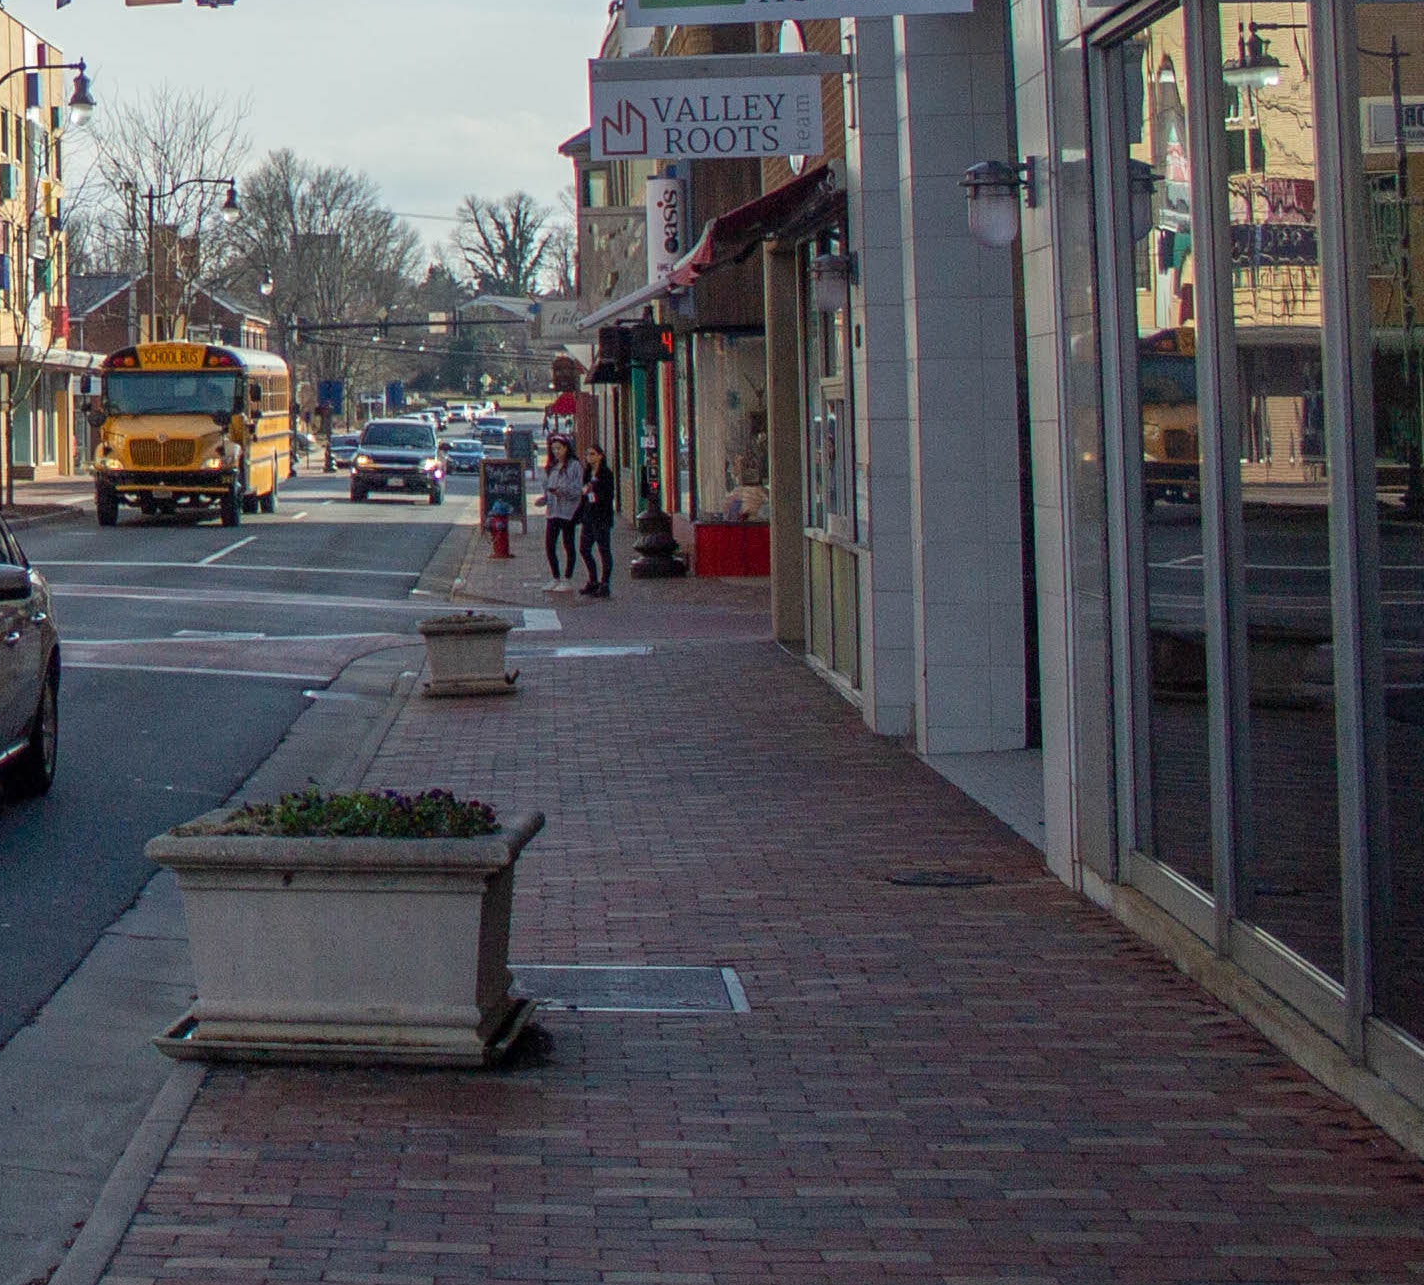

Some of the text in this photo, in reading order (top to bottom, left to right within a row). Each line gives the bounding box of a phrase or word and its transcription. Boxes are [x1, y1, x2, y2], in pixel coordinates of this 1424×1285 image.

[649, 92, 786, 123] VALLEY
[794, 92, 811, 150] team
[663, 125, 780, 154] ROOTS
[660, 331, 674, 354] 4
[144, 350, 199, 365] SCHOOL BUS
